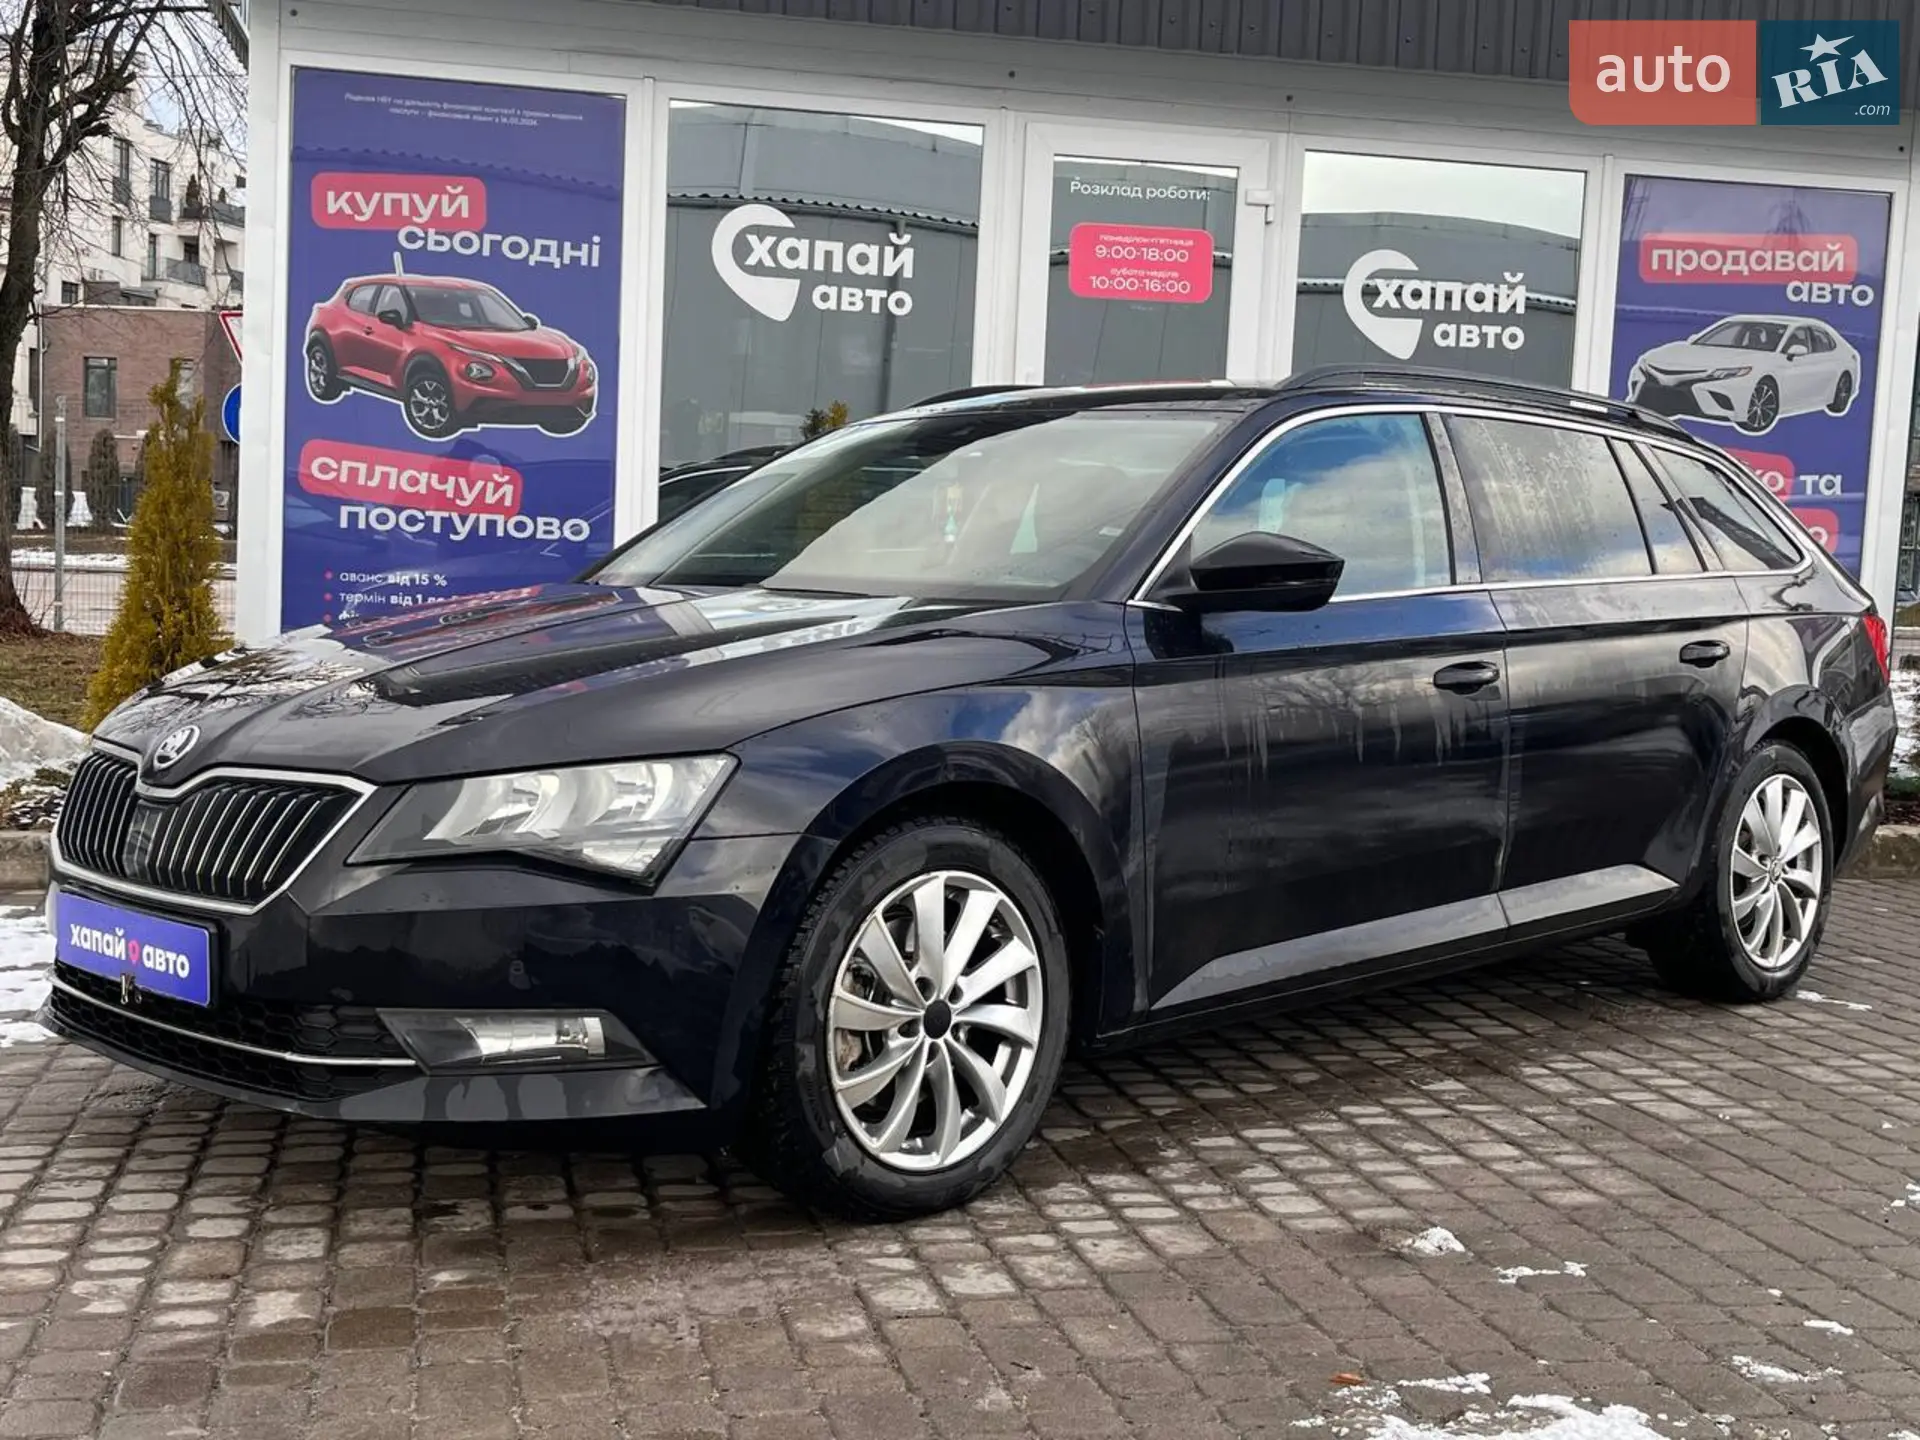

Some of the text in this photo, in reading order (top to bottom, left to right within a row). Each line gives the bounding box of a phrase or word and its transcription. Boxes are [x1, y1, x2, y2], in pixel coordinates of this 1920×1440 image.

[326, 185, 470, 222] купуй
[1070, 180, 1210, 201] Розклад роботи:
[397, 226, 601, 268] сьогодні
[744, 232, 915, 279] хапай
[1095, 244, 1189, 263] 9:00-18:00
[1651, 242, 1844, 275] продавай
[811, 284, 913, 316] авто
[1089, 275, 1191, 294] 10:00-16:00
[1372, 271, 1527, 315] хапай
[1786, 280, 1874, 306] авто
[1433, 323, 1525, 350] авто
[310, 456, 515, 507] сплачуй
[1800, 474, 1842, 495] та
[339, 504, 591, 542] поступово
[339, 571, 448, 587] аванс від 15 %
[339, 591, 386, 605] термін
[390, 591, 413, 606] від
[69, 923, 190, 979] хапай авто
